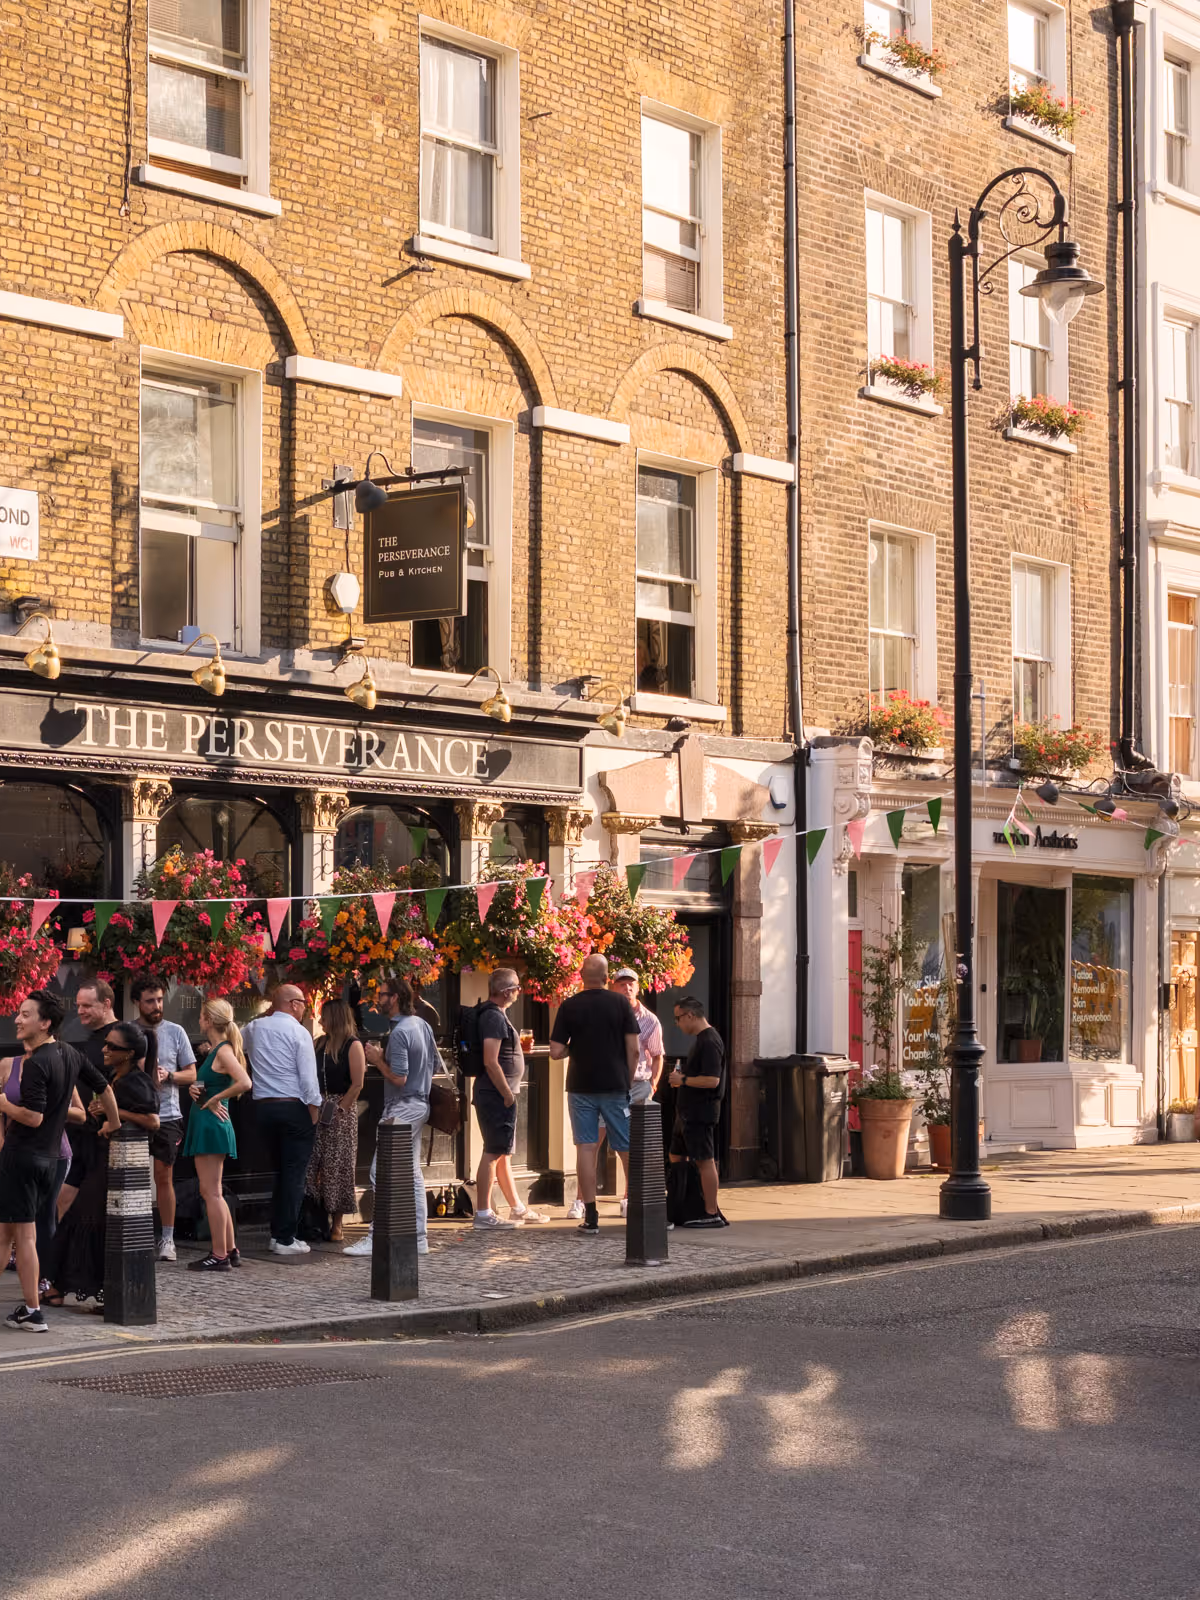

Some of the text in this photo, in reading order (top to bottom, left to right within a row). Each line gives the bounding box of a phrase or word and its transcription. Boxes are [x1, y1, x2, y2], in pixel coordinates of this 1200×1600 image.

[9, 536, 33, 551] WC1
[378, 536, 398, 548] THE
[378, 545, 451, 562] PERSEVERANCE
[398, 568, 405, 577] &
[74, 702, 491, 779] THE PERSEVERANCE
[1073, 982, 1099, 994] Removal
[903, 993, 922, 1007] Your
[1072, 996, 1086, 1009] Skin
[1072, 1011, 1112, 1025] Rejuvenation
[903, 1029, 922, 1042] Your
